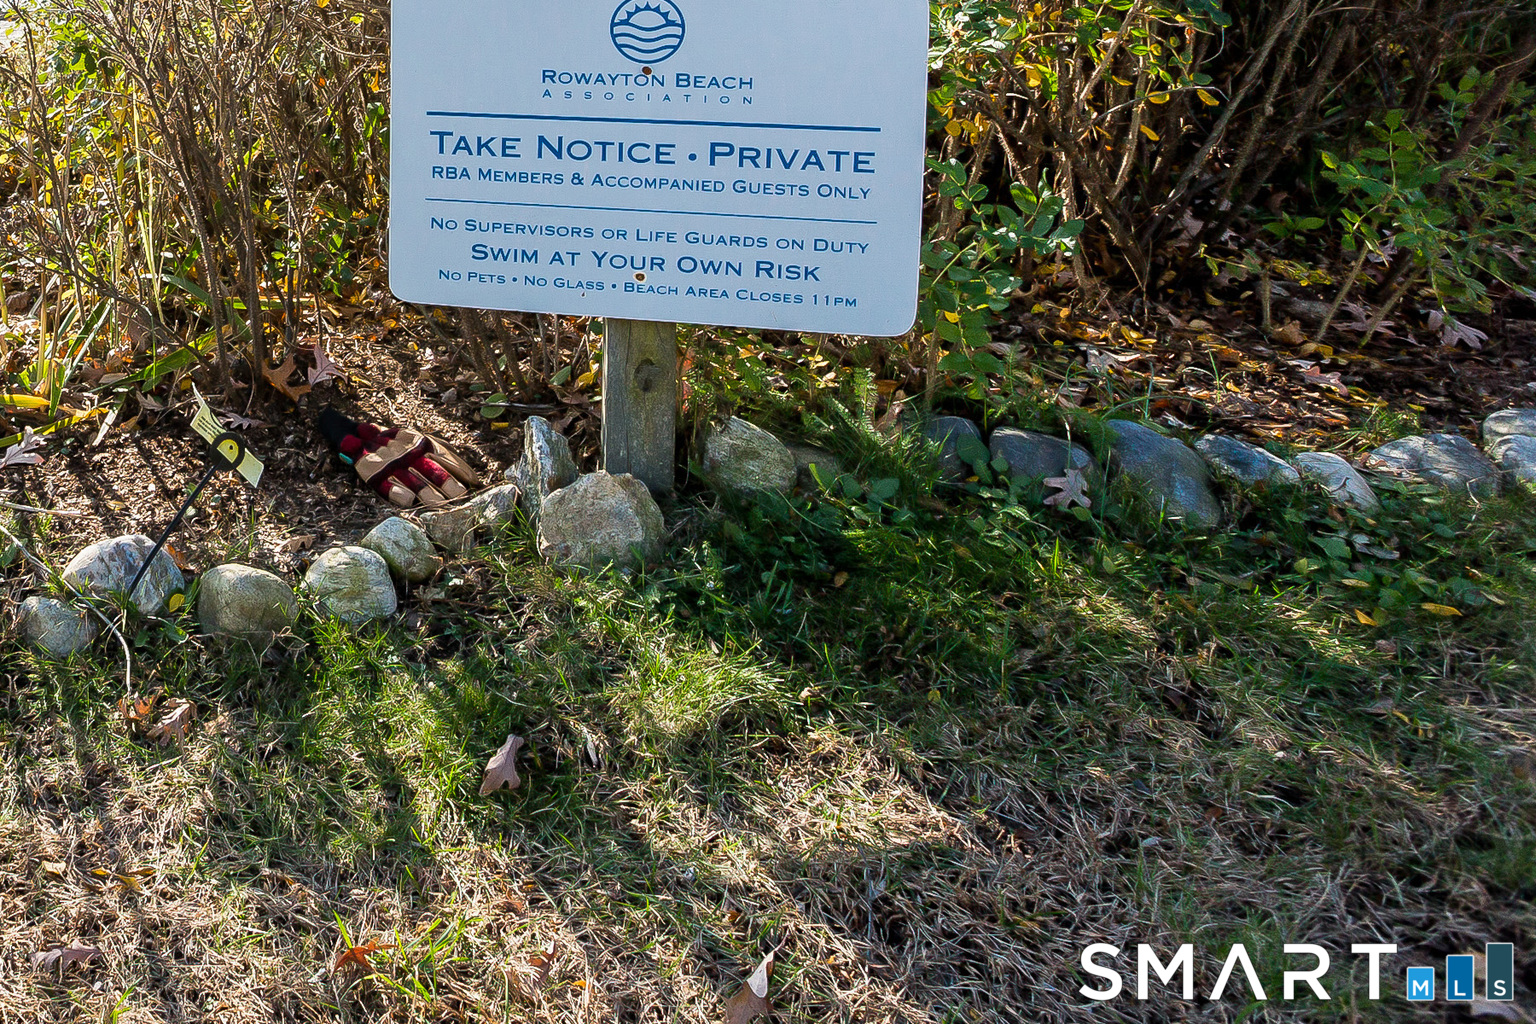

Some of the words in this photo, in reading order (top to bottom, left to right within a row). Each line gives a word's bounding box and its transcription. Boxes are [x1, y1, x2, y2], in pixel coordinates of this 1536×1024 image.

[541, 68, 665, 88] ROWAYTON
[675, 72, 753, 90] BEACH
[542, 88, 753, 105] ASSOCIATION
[429, 130, 522, 159] TAKE
[536, 134, 677, 165] NOTICE
[708, 141, 876, 174] PRIVATE
[431, 165, 471, 181] RBA
[478, 167, 564, 185] MEMBERS
[570, 171, 585, 186] &
[590, 173, 725, 193] ACCOMPANIED
[732, 179, 810, 197] GUESTS
[816, 183, 871, 200] ONLY
[430, 216, 458, 231] NO
[464, 218, 595, 239] SUPERVISORS
[601, 228, 628, 241] OR
[635, 228, 678, 244] LIFE
[684, 231, 768, 249] GUARDS
[775, 238, 805, 251] ON
[813, 238, 870, 255] DUTY
[471, 243, 539, 265] SWIM
[548, 250, 581, 267] AT
[590, 250, 666, 272] YOUR
[676, 255, 742, 277] OWN
[754, 260, 821, 282] RISK
[438, 268, 462, 281] NO
[467, 271, 506, 285] PETS
[524, 275, 548, 287] NO
[553, 277, 605, 291] GLASS
[623, 281, 679, 296] BEACH
[684, 285, 730, 300] AREA
[735, 289, 804, 304] CLOSES
[812, 293, 857, 308] 11PM
